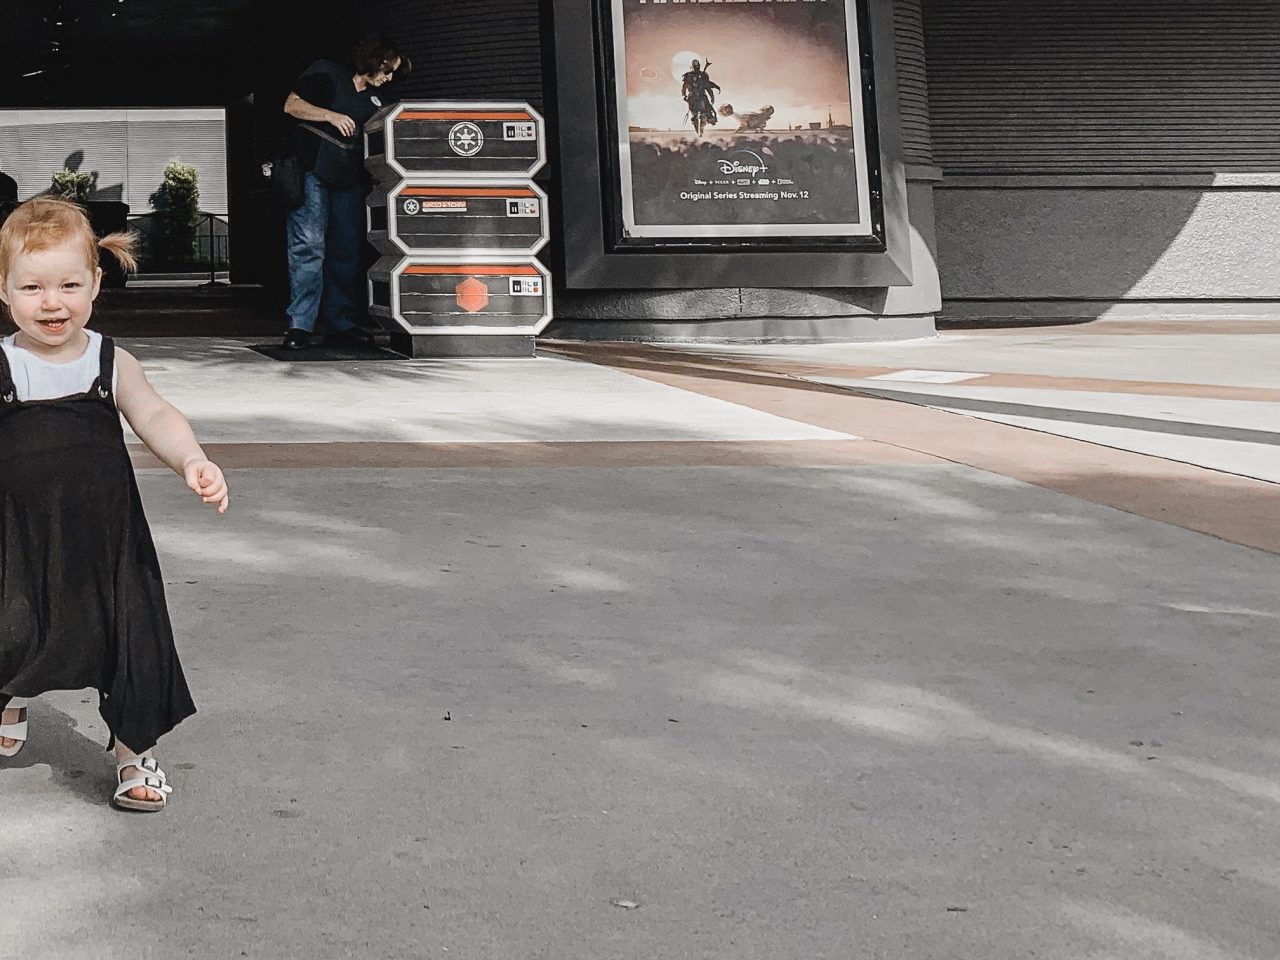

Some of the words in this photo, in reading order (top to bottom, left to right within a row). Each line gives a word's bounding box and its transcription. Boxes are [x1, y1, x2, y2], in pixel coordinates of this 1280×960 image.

[717, 156, 768, 177] Disney+
[680, 191, 712, 201] Original
[713, 191, 738, 199] Series
[739, 191, 779, 201] Streaming
[780, 190, 799, 199] Nov.
[799, 190, 809, 199] 12
